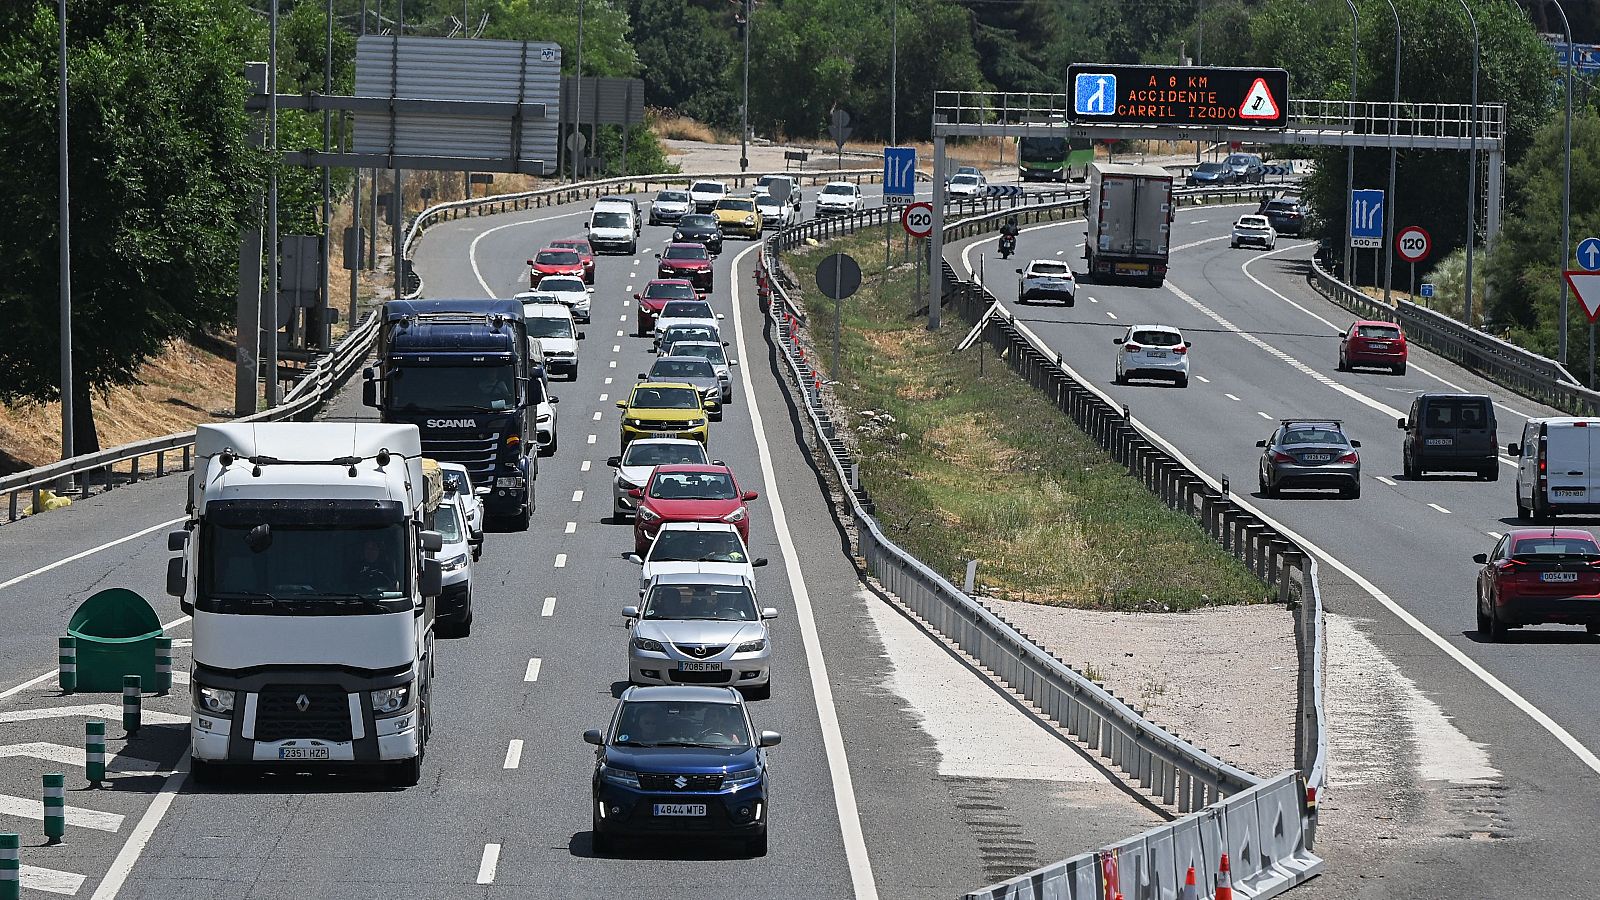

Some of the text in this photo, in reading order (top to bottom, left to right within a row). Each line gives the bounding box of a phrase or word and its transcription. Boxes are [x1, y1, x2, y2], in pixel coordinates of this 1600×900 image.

[1149, 75, 1208, 88] A 6 KM
[1128, 90, 1217, 104] ACCIDENTE
[1118, 105, 1236, 119] CARRIL IZQDO
[886, 196, 903, 204] 500
[908, 213, 931, 226] 120
[1353, 239, 1370, 247] 500
[1402, 238, 1424, 250] 120
[426, 418, 477, 428] SCANIA
[684, 662, 720, 671] 7085 FNR
[285, 749, 326, 758] 2351 HZP
[660, 805, 705, 815] 4844 MTB
